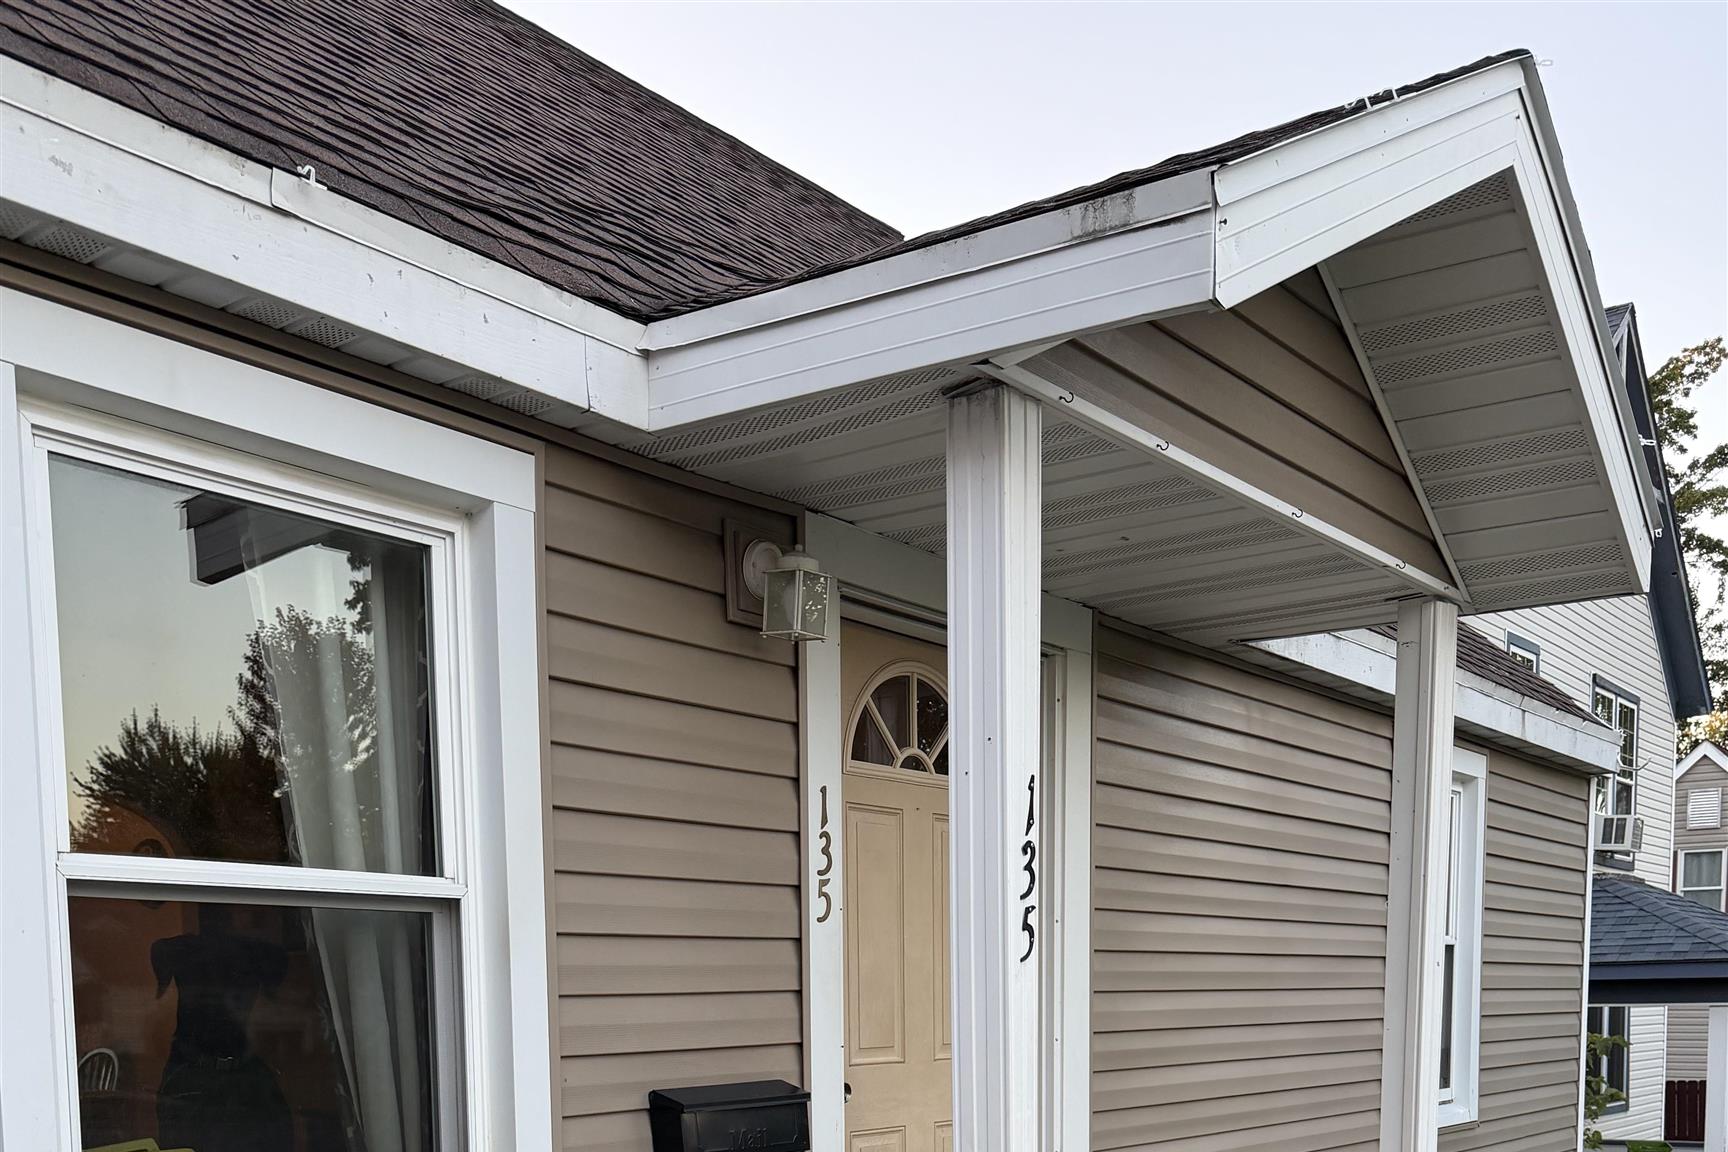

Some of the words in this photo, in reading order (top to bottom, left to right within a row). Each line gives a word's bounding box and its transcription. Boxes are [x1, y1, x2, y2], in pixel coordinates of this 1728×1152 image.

[816, 784, 833, 923] 135
[1019, 774, 1037, 963] 135
[728, 1127, 769, 1151] Mail
